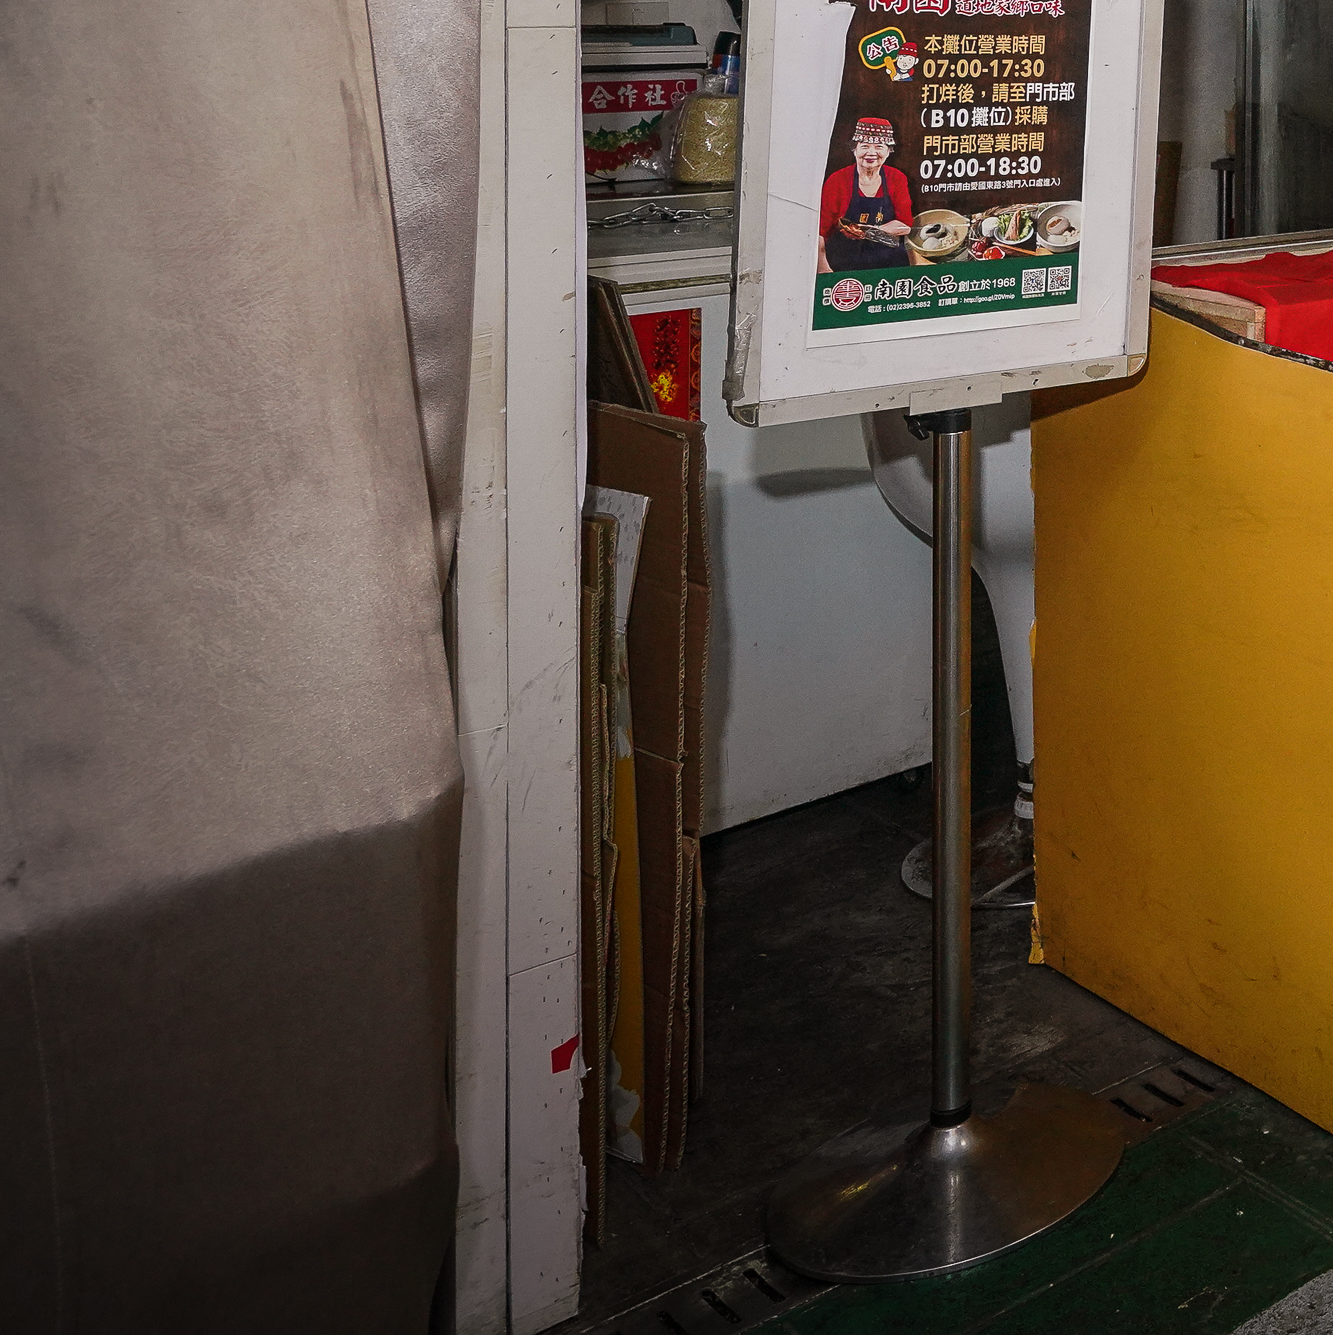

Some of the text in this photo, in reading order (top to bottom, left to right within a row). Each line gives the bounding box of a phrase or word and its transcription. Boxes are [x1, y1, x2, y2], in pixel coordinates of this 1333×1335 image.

[866, 35, 900, 60] 公告
[924, 35, 1046, 56] 本攤位營業時間
[922, 59, 1046, 79] 07:00-17:30
[588, 82, 669, 110] 合作社
[921, 82, 1076, 104] 打烊後，請至門市部
[923, 132, 1045, 156] 門市部營業時間
[919, 156, 1042, 179] 07:00-18:30
[874, 275, 958, 300] 南園食品
[957, 276, 1017, 293] 創立於1968
